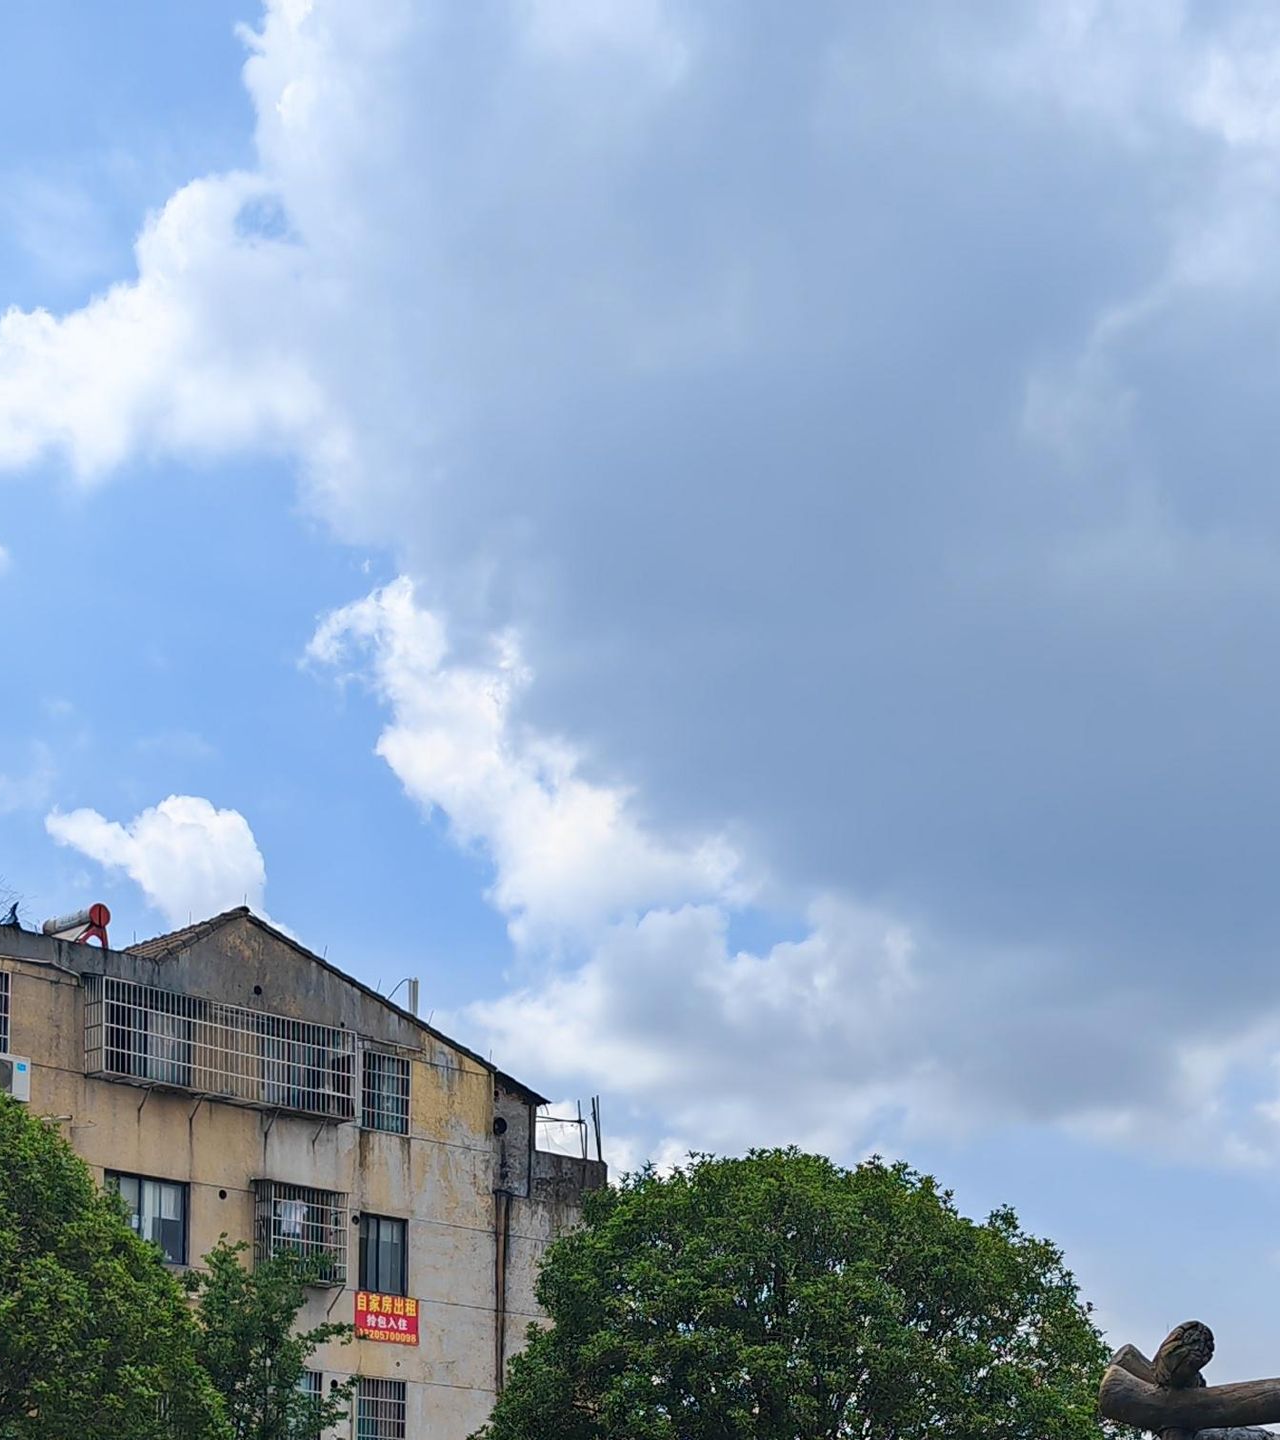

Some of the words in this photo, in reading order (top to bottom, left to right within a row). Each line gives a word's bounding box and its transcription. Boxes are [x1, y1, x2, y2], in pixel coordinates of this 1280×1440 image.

[357, 1293, 417, 1317] 自家房出租
